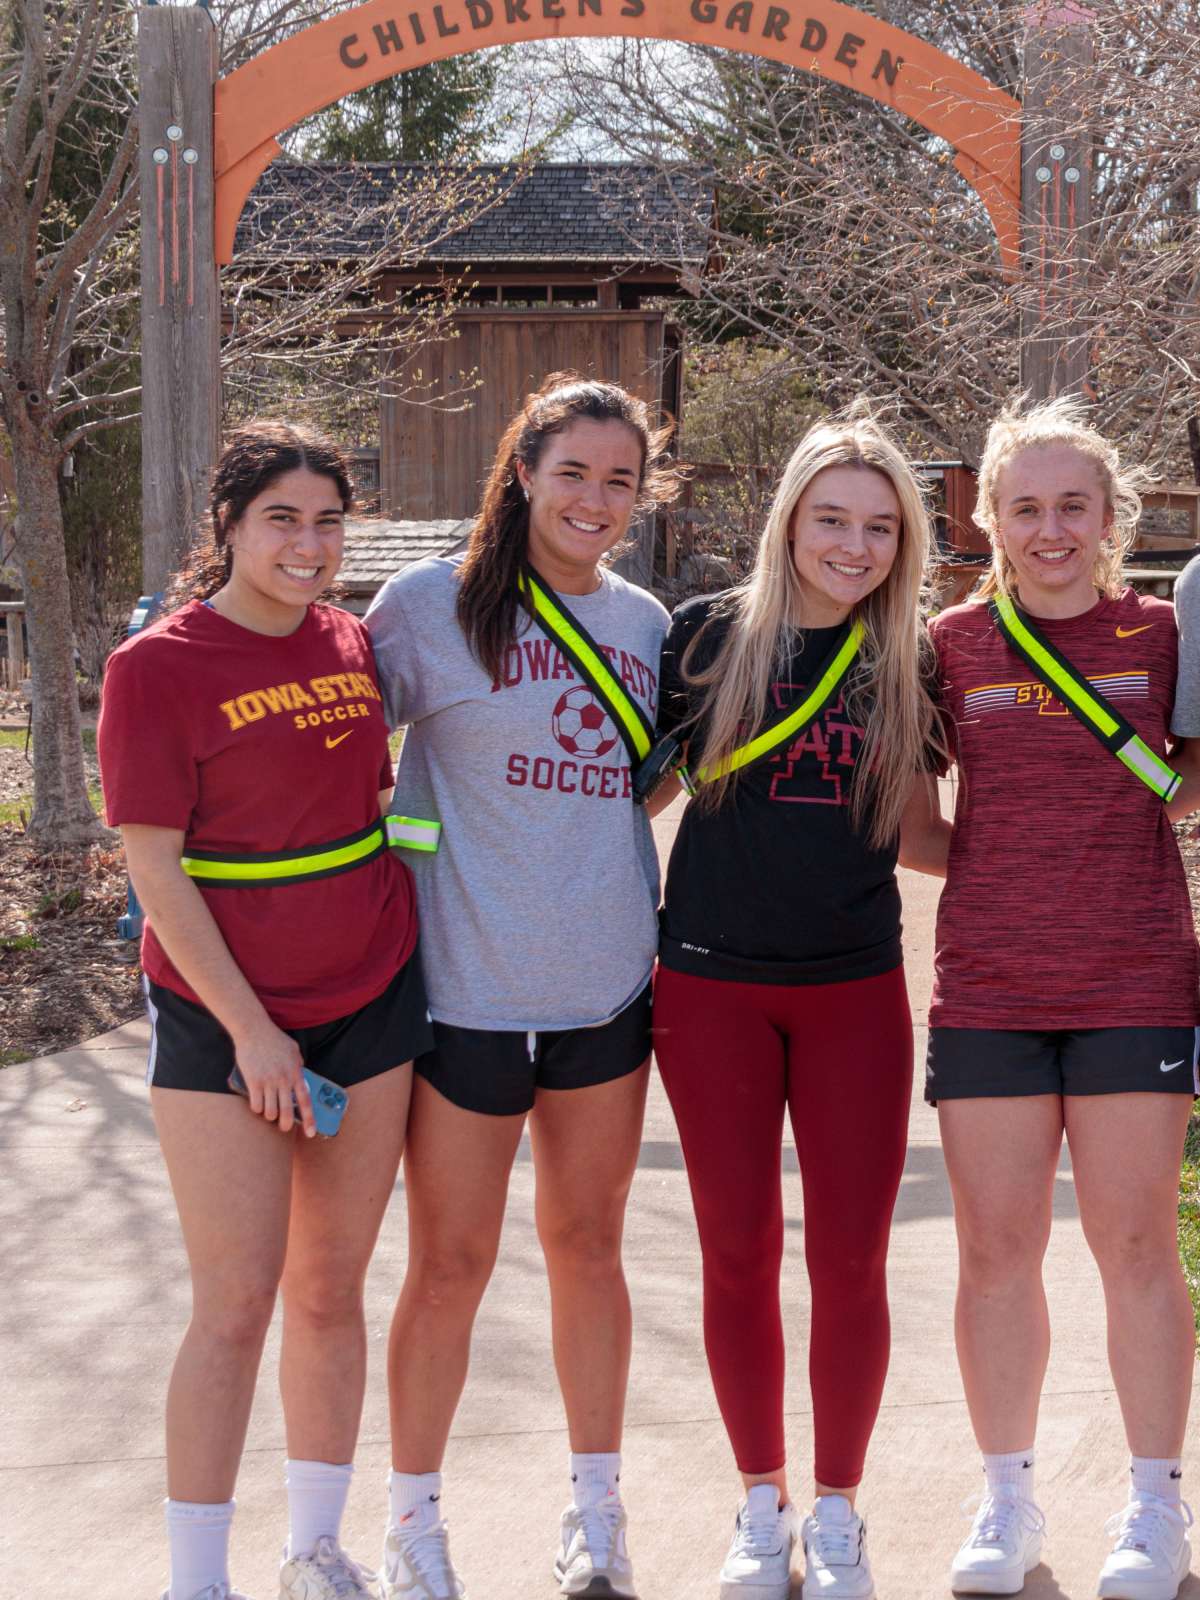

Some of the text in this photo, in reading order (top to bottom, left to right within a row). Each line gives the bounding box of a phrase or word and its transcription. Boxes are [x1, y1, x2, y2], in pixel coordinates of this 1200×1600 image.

[690, 0, 904, 86] GARDEN
[490, 639, 575, 693] OWA
[219, 682, 316, 731] IOWA
[294, 703, 370, 729] SOCCER
[681, 942, 711, 955] DRI-FIT
